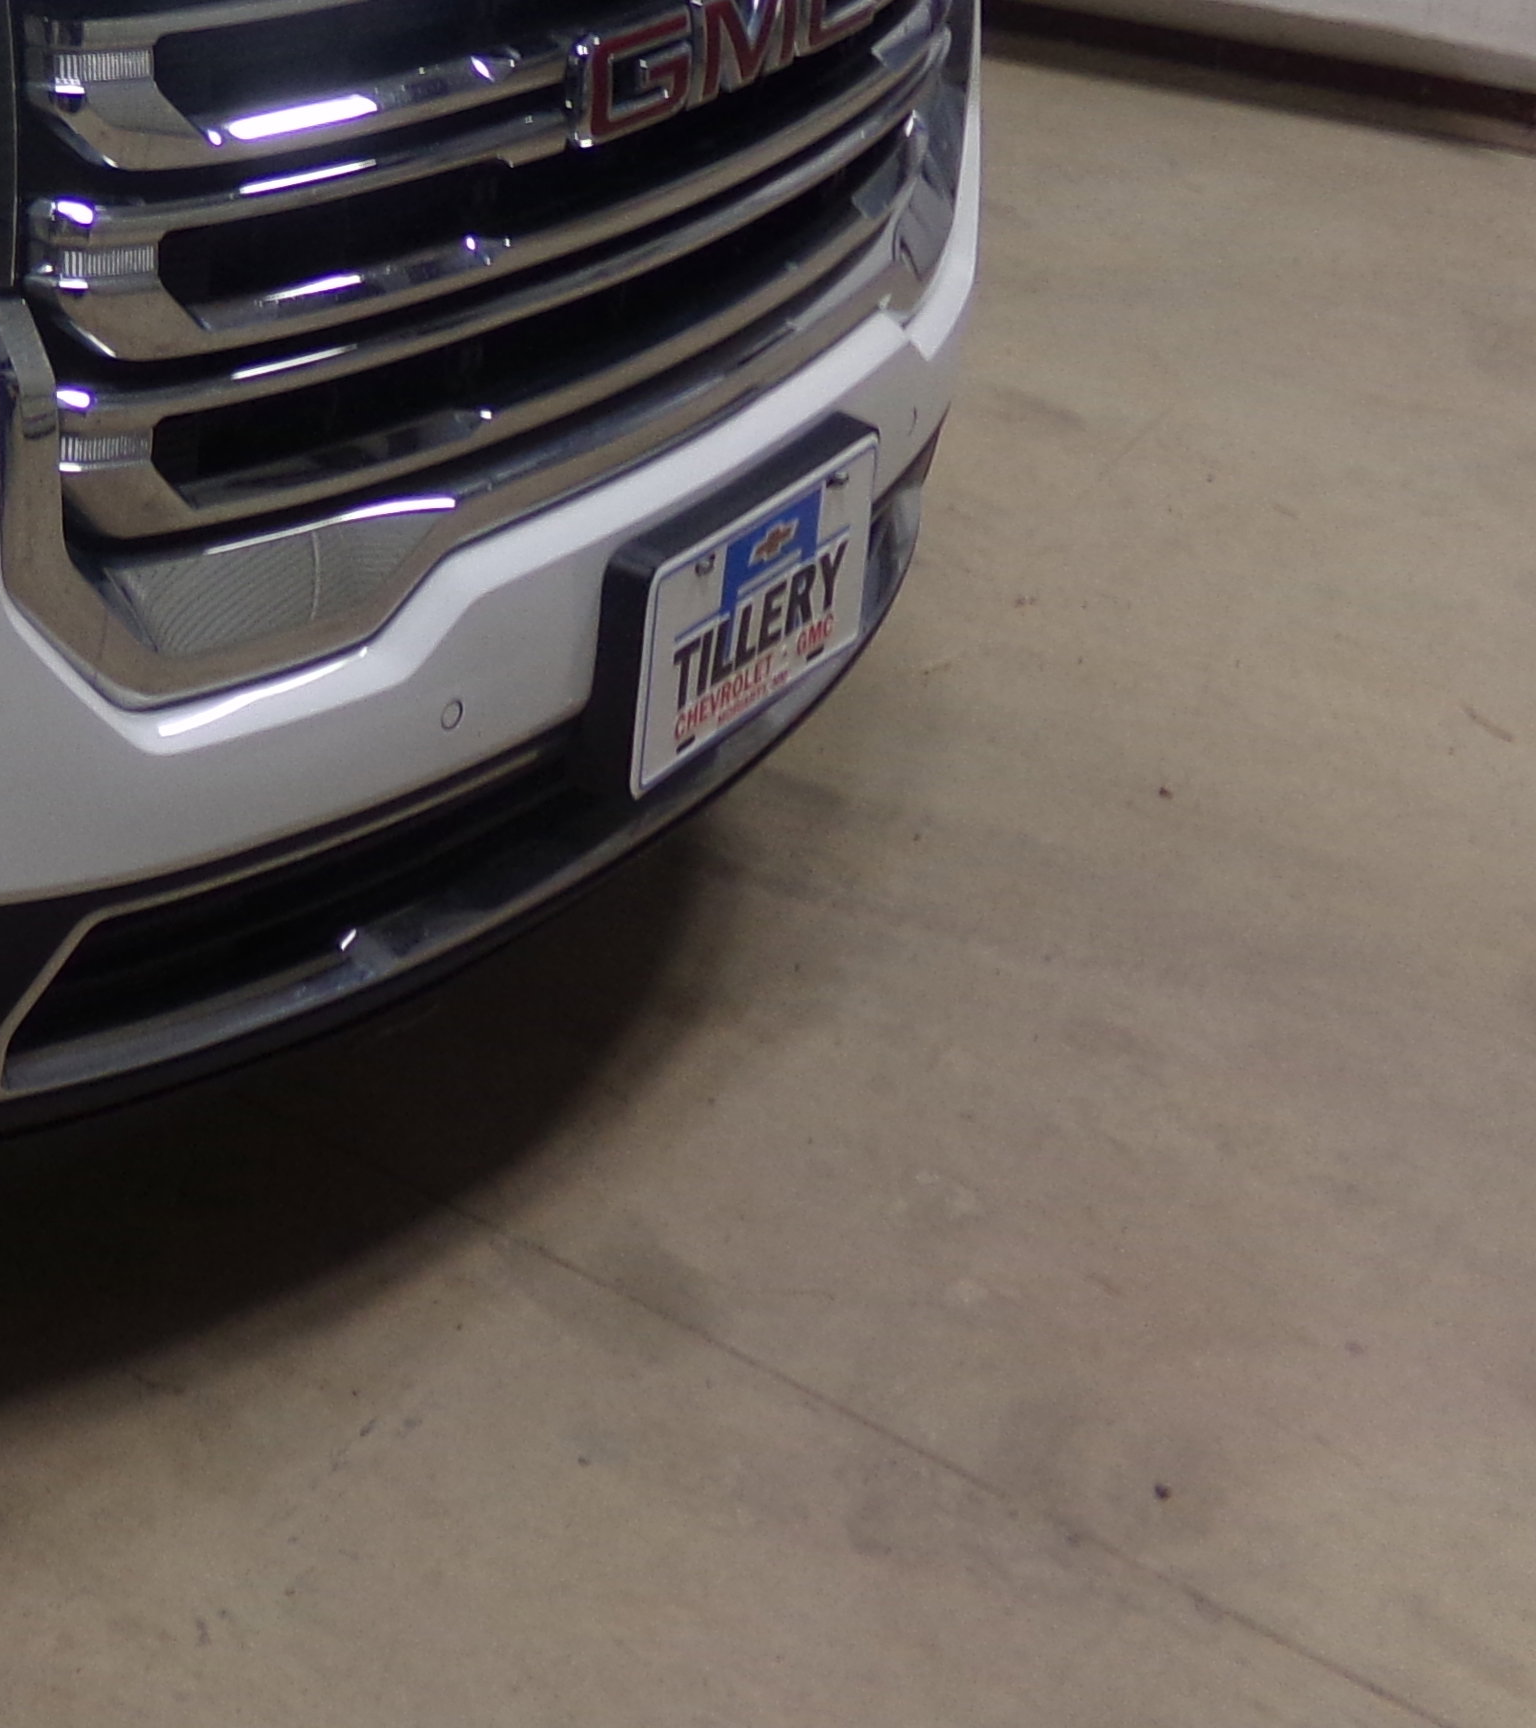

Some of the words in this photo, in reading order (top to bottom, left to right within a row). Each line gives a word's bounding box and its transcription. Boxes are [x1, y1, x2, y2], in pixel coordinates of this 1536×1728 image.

[673, 539, 848, 710] TILLERY
[674, 654, 772, 741] CHEVROLET
[796, 612, 835, 656] GMC
